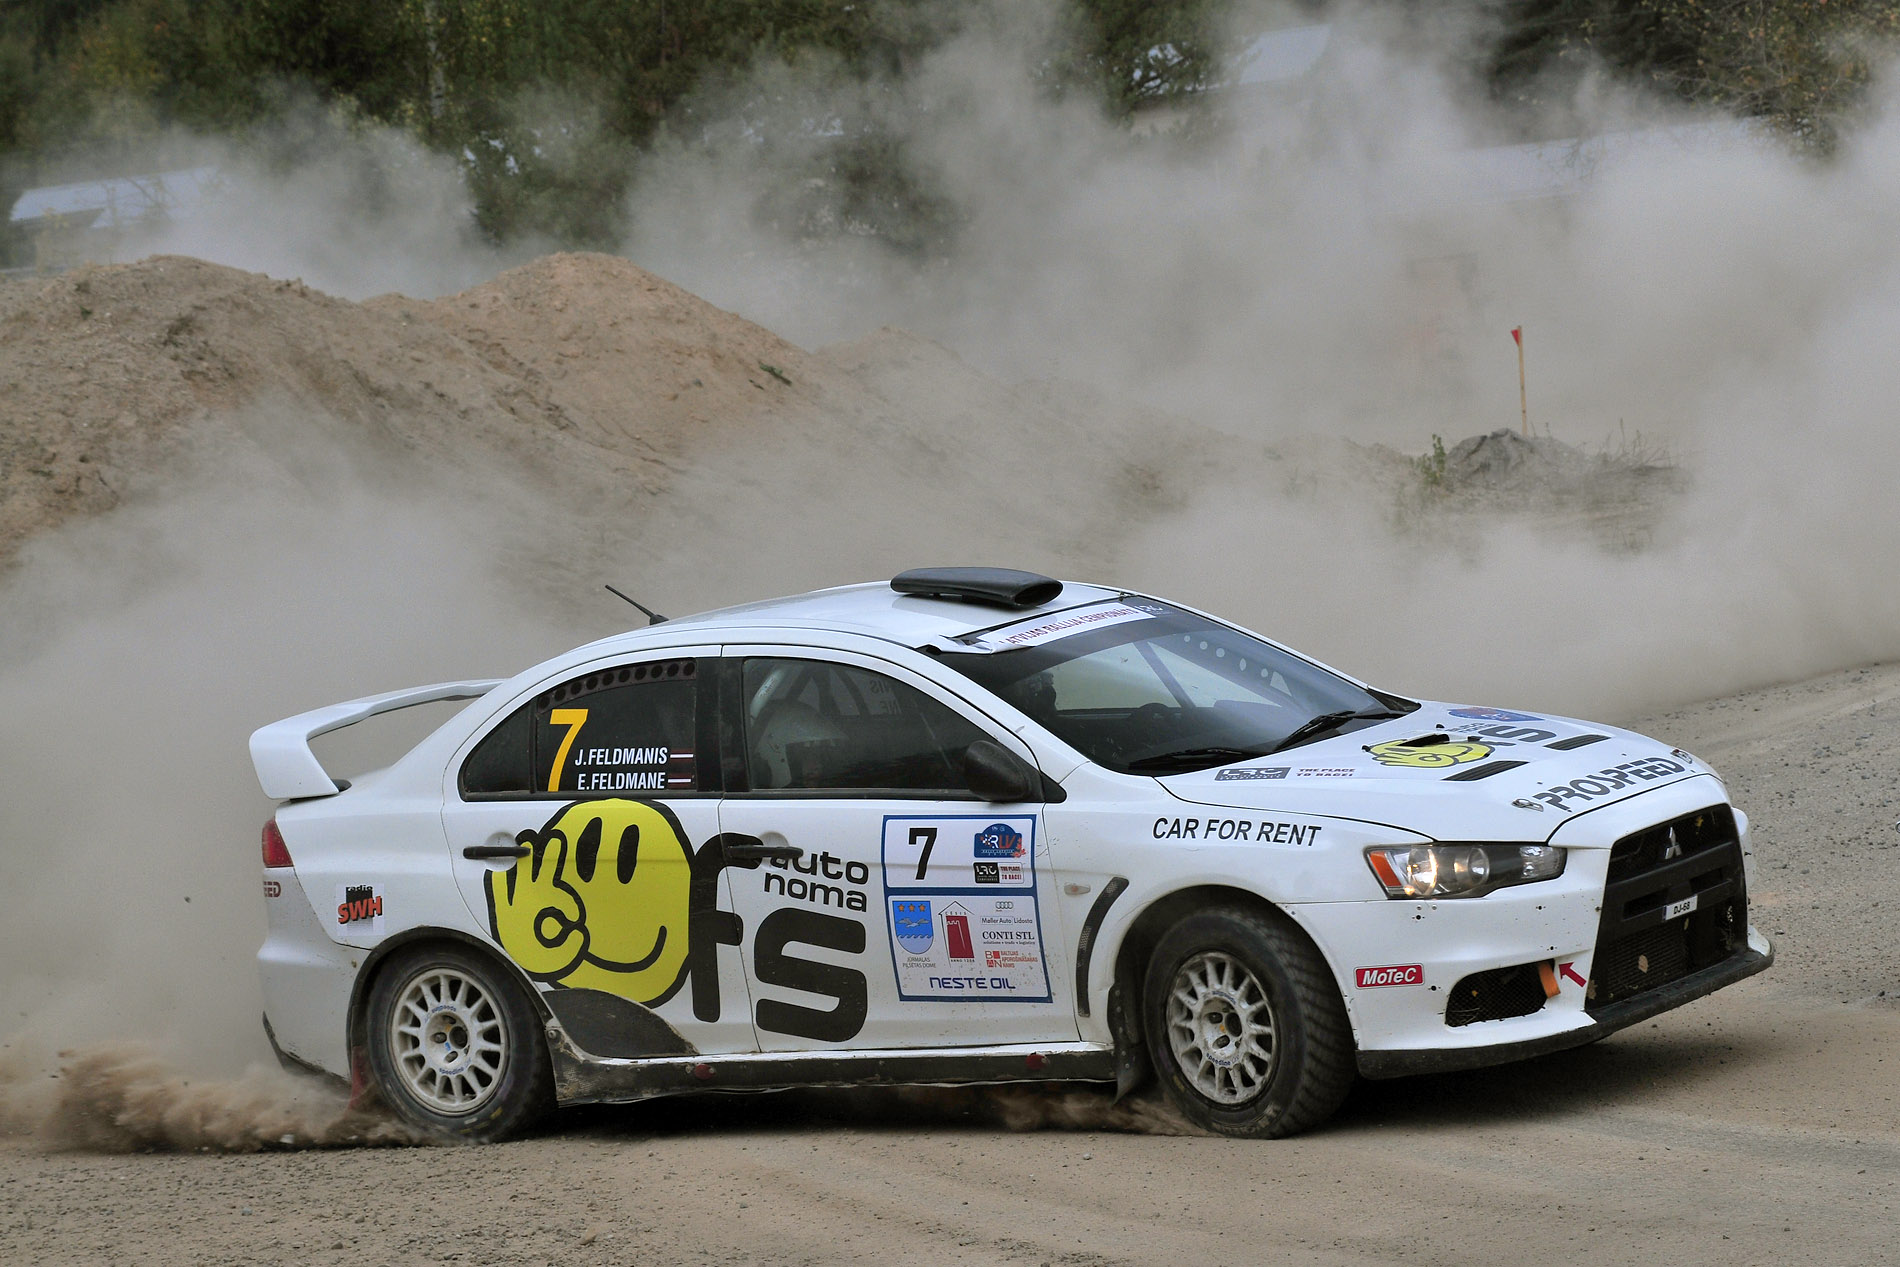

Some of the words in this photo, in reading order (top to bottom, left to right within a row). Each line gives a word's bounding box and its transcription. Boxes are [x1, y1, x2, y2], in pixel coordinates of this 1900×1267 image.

[548, 709, 588, 792] 7
[575, 747, 667, 765] J.FELDMANIS
[577, 772, 665, 790] E.FELDMANE
[1532, 757, 1686, 813] PROSPEED
[1153, 817, 1199, 839] CAR
[1204, 819, 1251, 841] FOR
[1257, 822, 1322, 847] RENT
[769, 851, 868, 884] auto
[908, 827, 938, 881] 7
[764, 872, 867, 912] noma
[338, 896, 383, 924] SWH
[1674, 901, 1691, 914] DJ-68
[982, 931, 1013, 940] CONTI
[1015, 931, 1035, 940] STL
[930, 977, 988, 989] NESTE
[991, 978, 1016, 989] OIL
[1362, 966, 1416, 985] MoTeC
